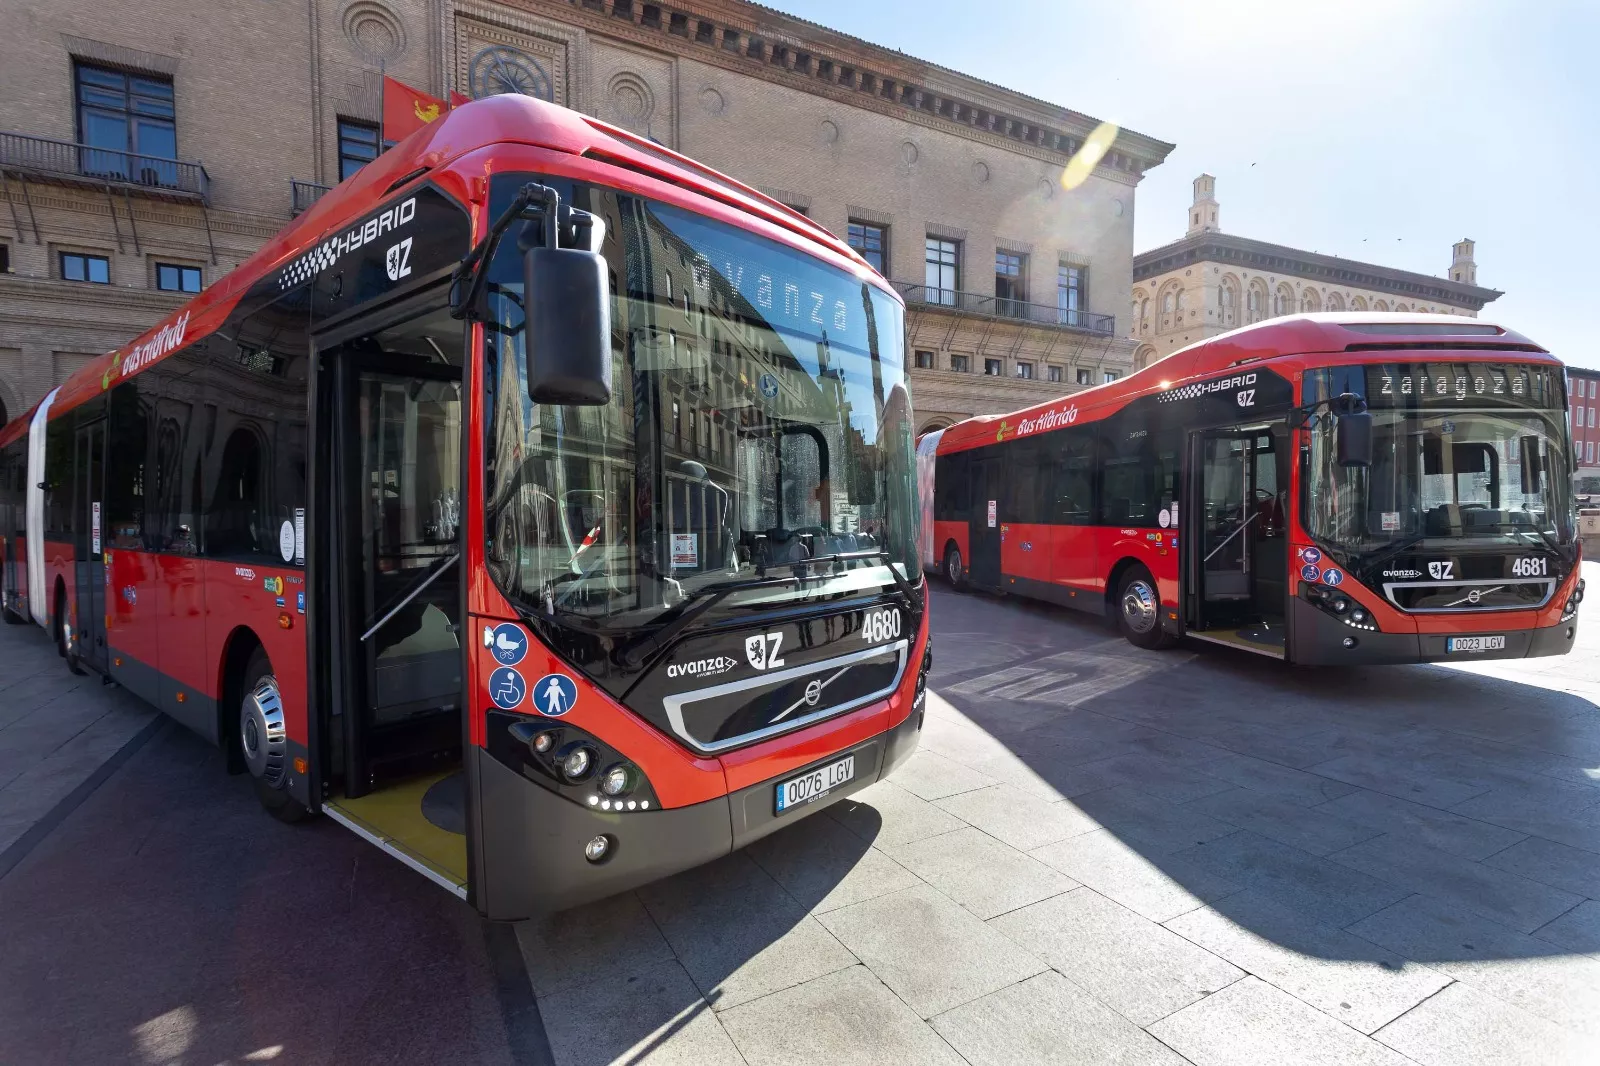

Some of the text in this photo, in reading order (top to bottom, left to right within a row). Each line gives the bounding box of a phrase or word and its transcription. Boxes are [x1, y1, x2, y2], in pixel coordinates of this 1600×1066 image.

[337, 198, 416, 258] HYBRID
[693, 252, 847, 331] avanza
[1201, 373, 1257, 395] HYBRID
[1381, 376, 1523, 400] zaragoza
[1017, 418, 1036, 436] Bus
[1382, 569, 1415, 578] avanza
[1512, 557, 1547, 577] 4681
[861, 608, 901, 643] 4680
[1455, 637, 1503, 650] 0023 LGV
[667, 656, 725, 678] avanza
[789, 759, 851, 803] 0076 LGV
